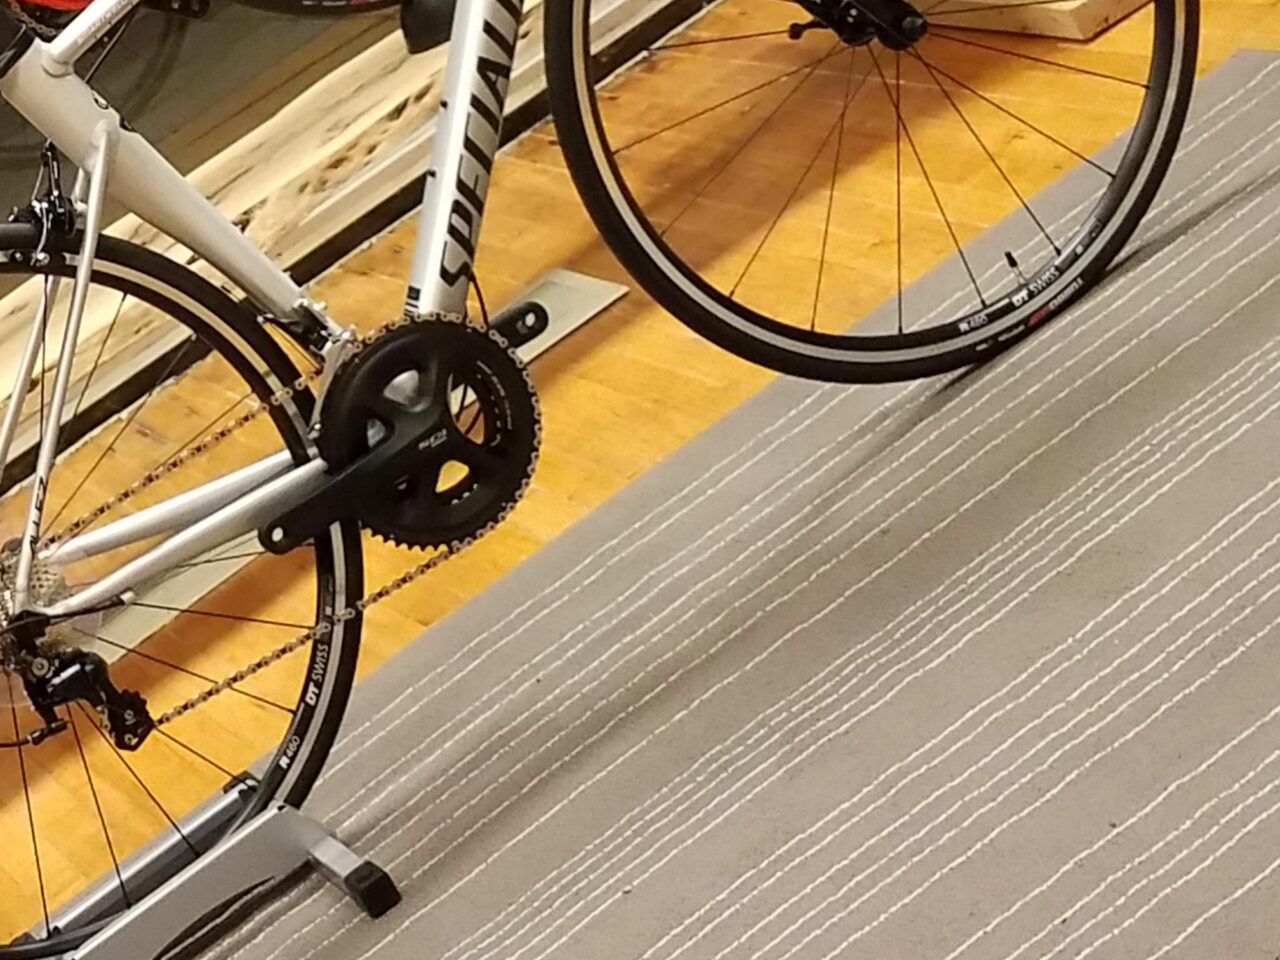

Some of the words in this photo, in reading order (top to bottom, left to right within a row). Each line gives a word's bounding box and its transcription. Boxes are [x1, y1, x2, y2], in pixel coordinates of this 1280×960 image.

[1010, 287, 1030, 307] DT
[1028, 265, 1061, 296] SWISS
[311, 643, 329, 683] SWISS
[305, 680, 320, 707] DT
